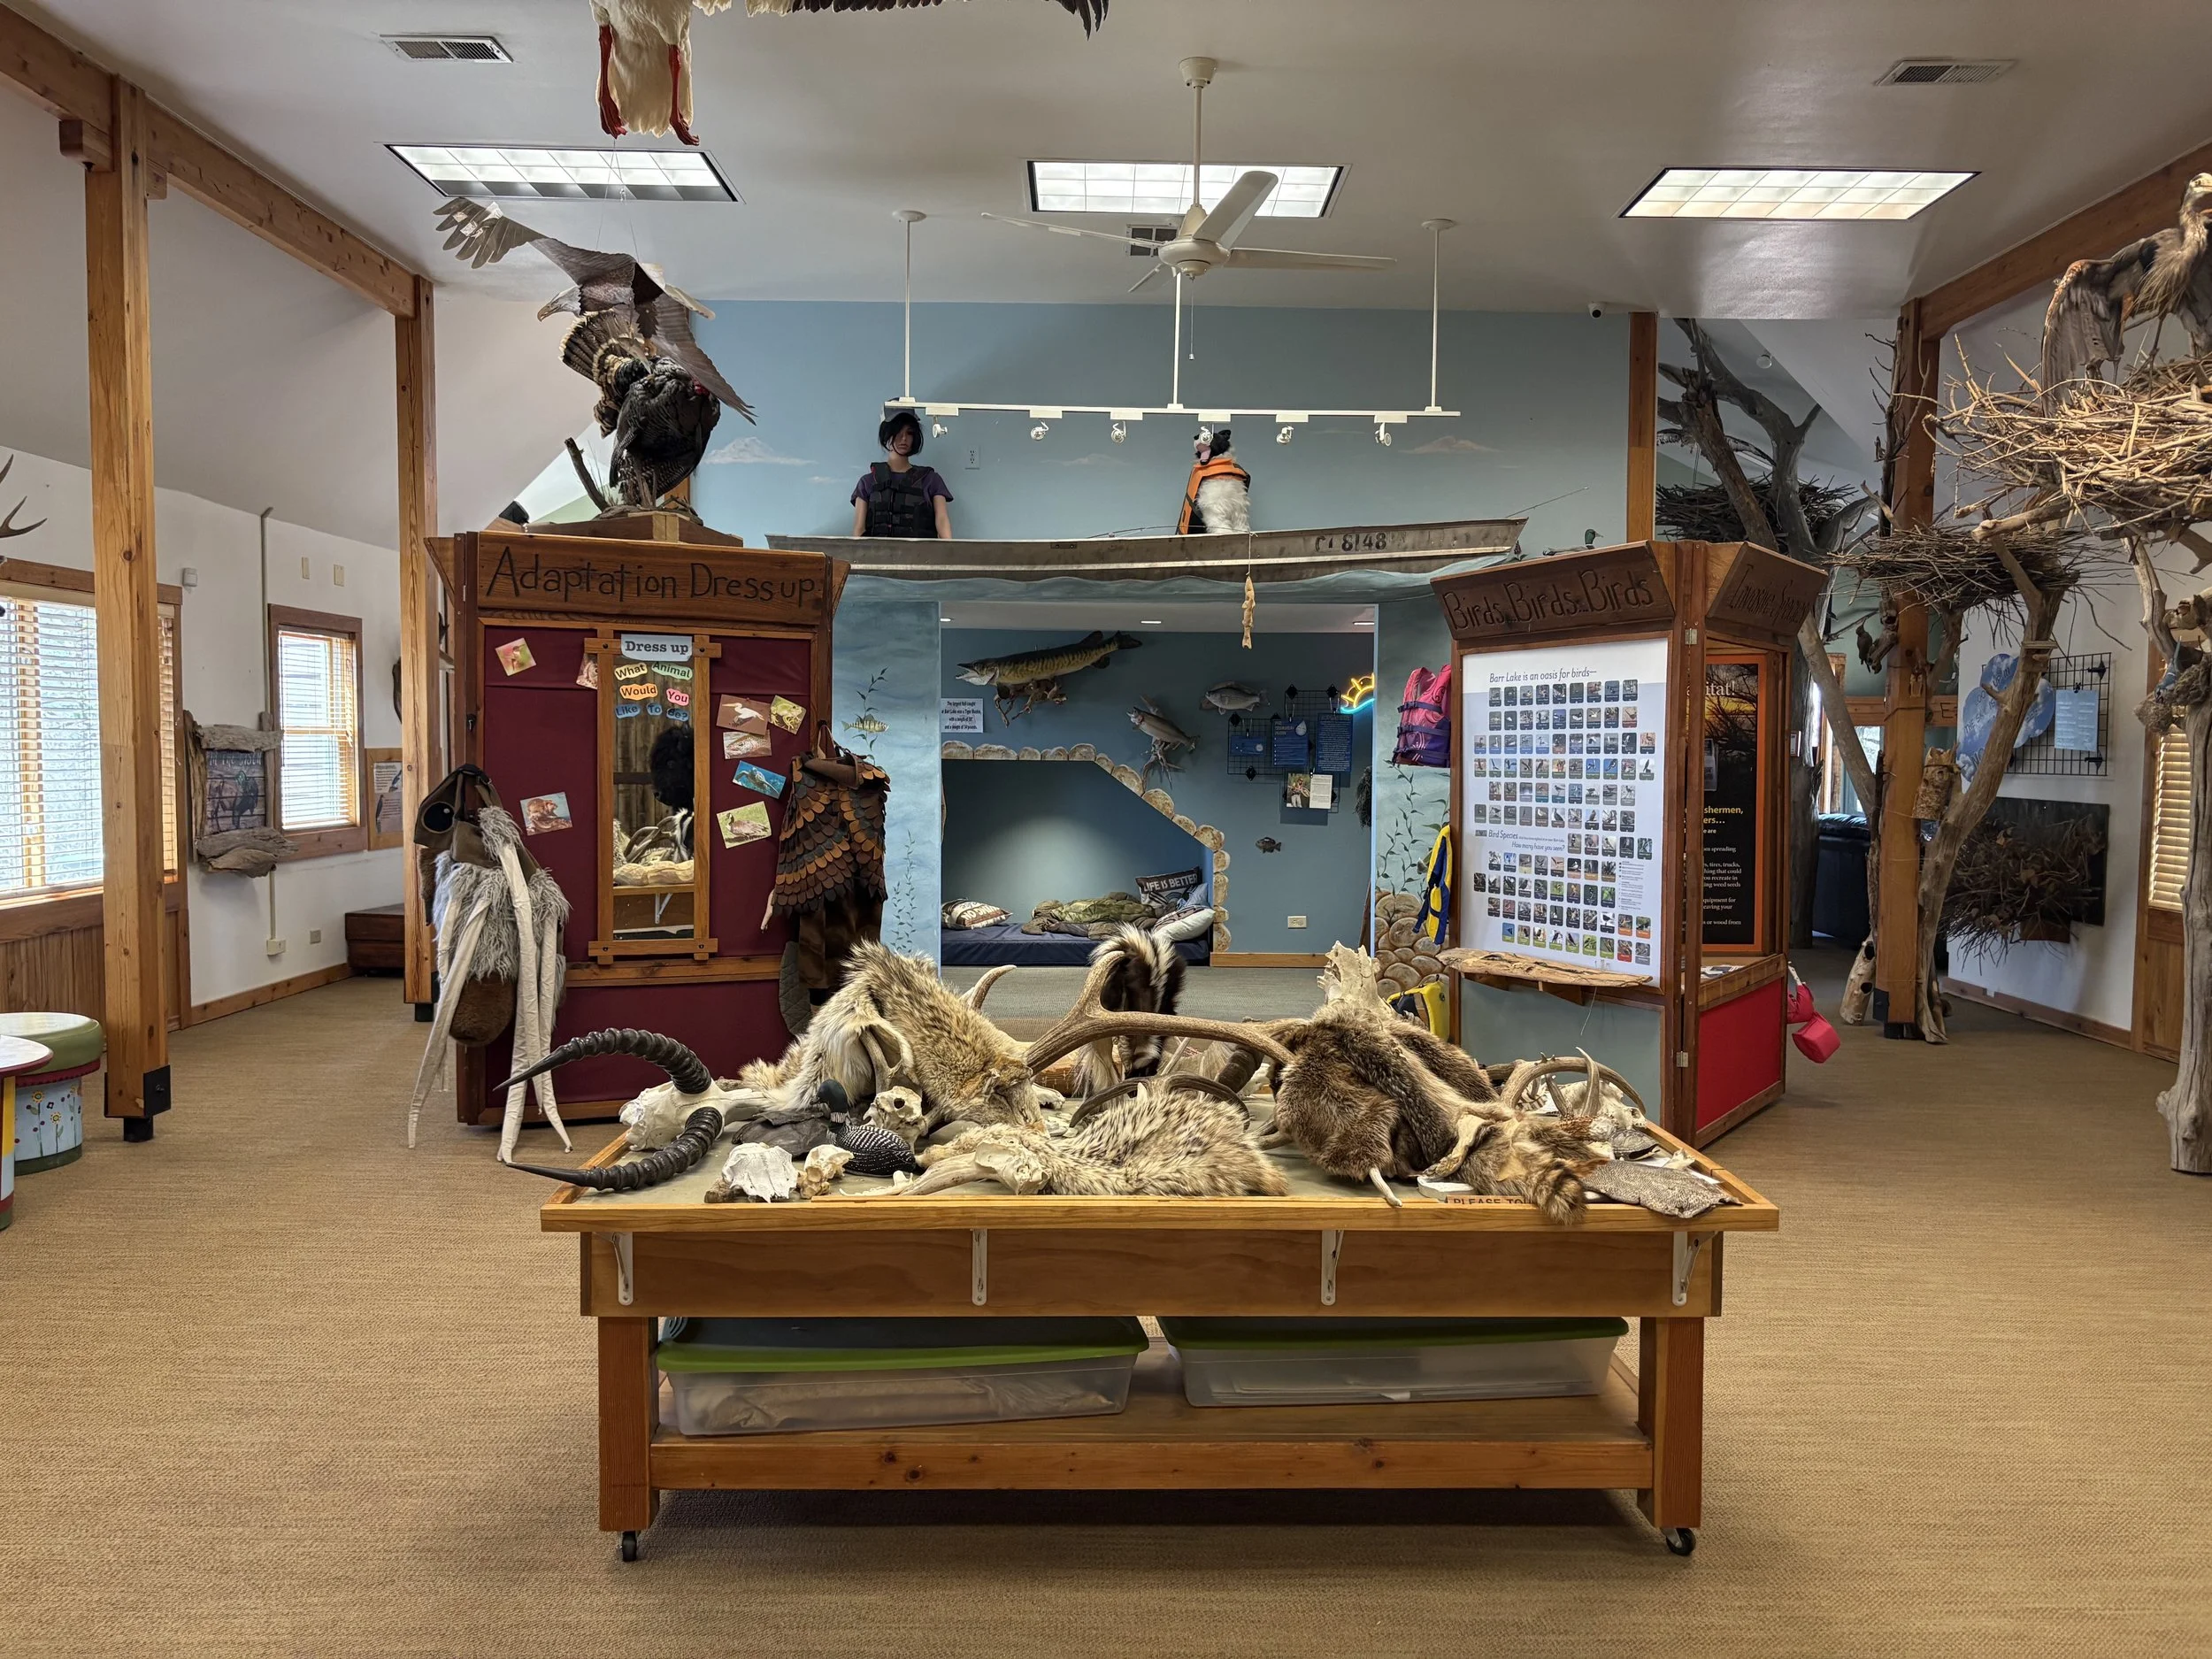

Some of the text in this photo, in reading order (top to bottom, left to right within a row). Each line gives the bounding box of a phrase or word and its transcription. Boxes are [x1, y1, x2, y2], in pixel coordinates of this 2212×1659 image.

[1342, 532, 1386, 551] 8148
[487, 546, 677, 602] Adaptation
[625, 641, 688, 655] Dress up
[616, 661, 690, 678] What Animal
[1489, 672, 1504, 683] Barr
[1506, 672, 1521, 681] Lake
[1523, 672, 1528, 680] is
[1540, 670, 1557, 680] oasis
[1558, 668, 1571, 681] for
[621, 686, 687, 703] Would You
[616, 705, 687, 720] Like To Be?
[1703, 805, 1744, 815] shermen,
[1500, 830, 1518, 840] Species
[1143, 873, 1198, 892] LIFE IS BETTER
